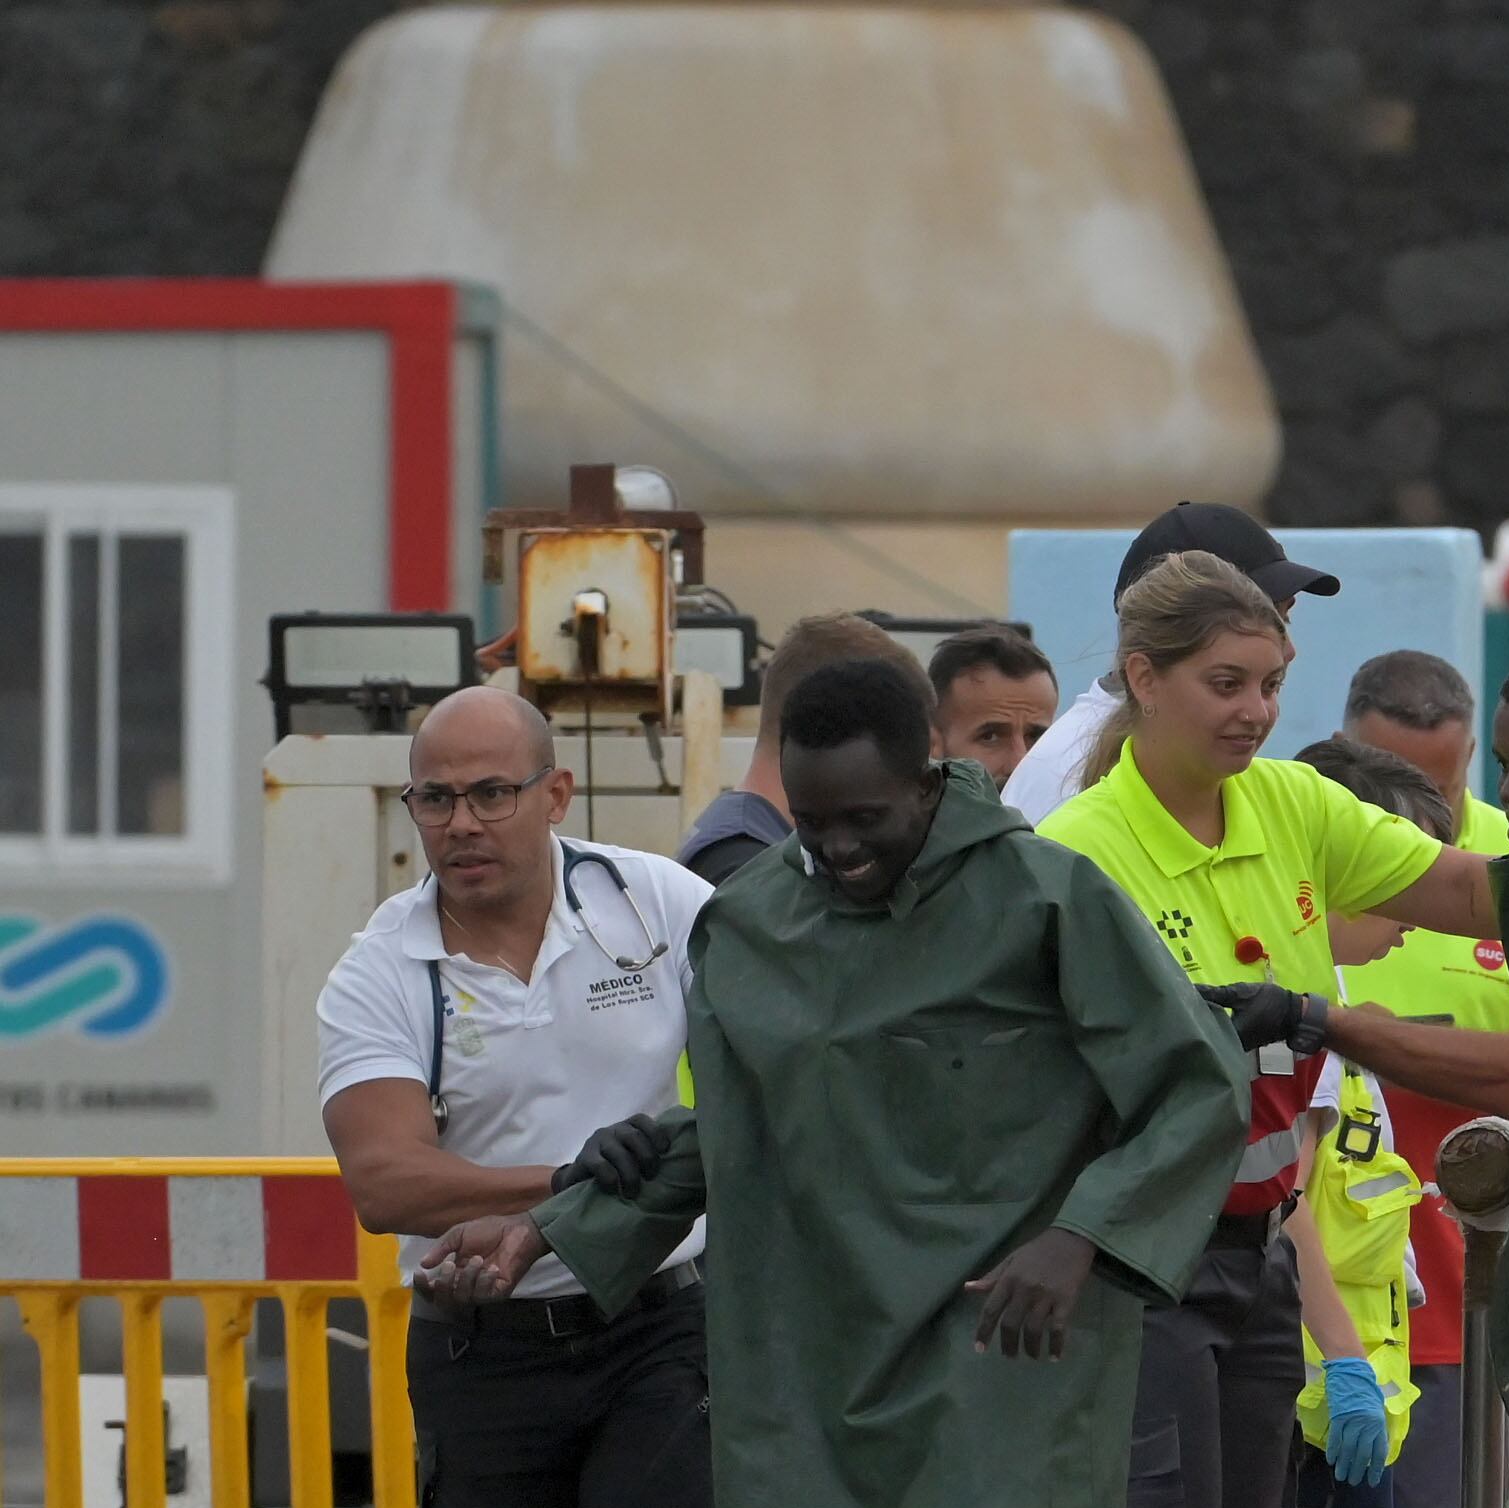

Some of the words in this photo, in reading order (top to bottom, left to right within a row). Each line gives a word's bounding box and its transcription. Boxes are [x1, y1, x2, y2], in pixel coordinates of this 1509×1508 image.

[1476, 947, 1505, 962] SUC
[586, 991, 618, 1004] Hospital
[590, 1004, 600, 1012] de
[601, 1001, 617, 1009] Los
